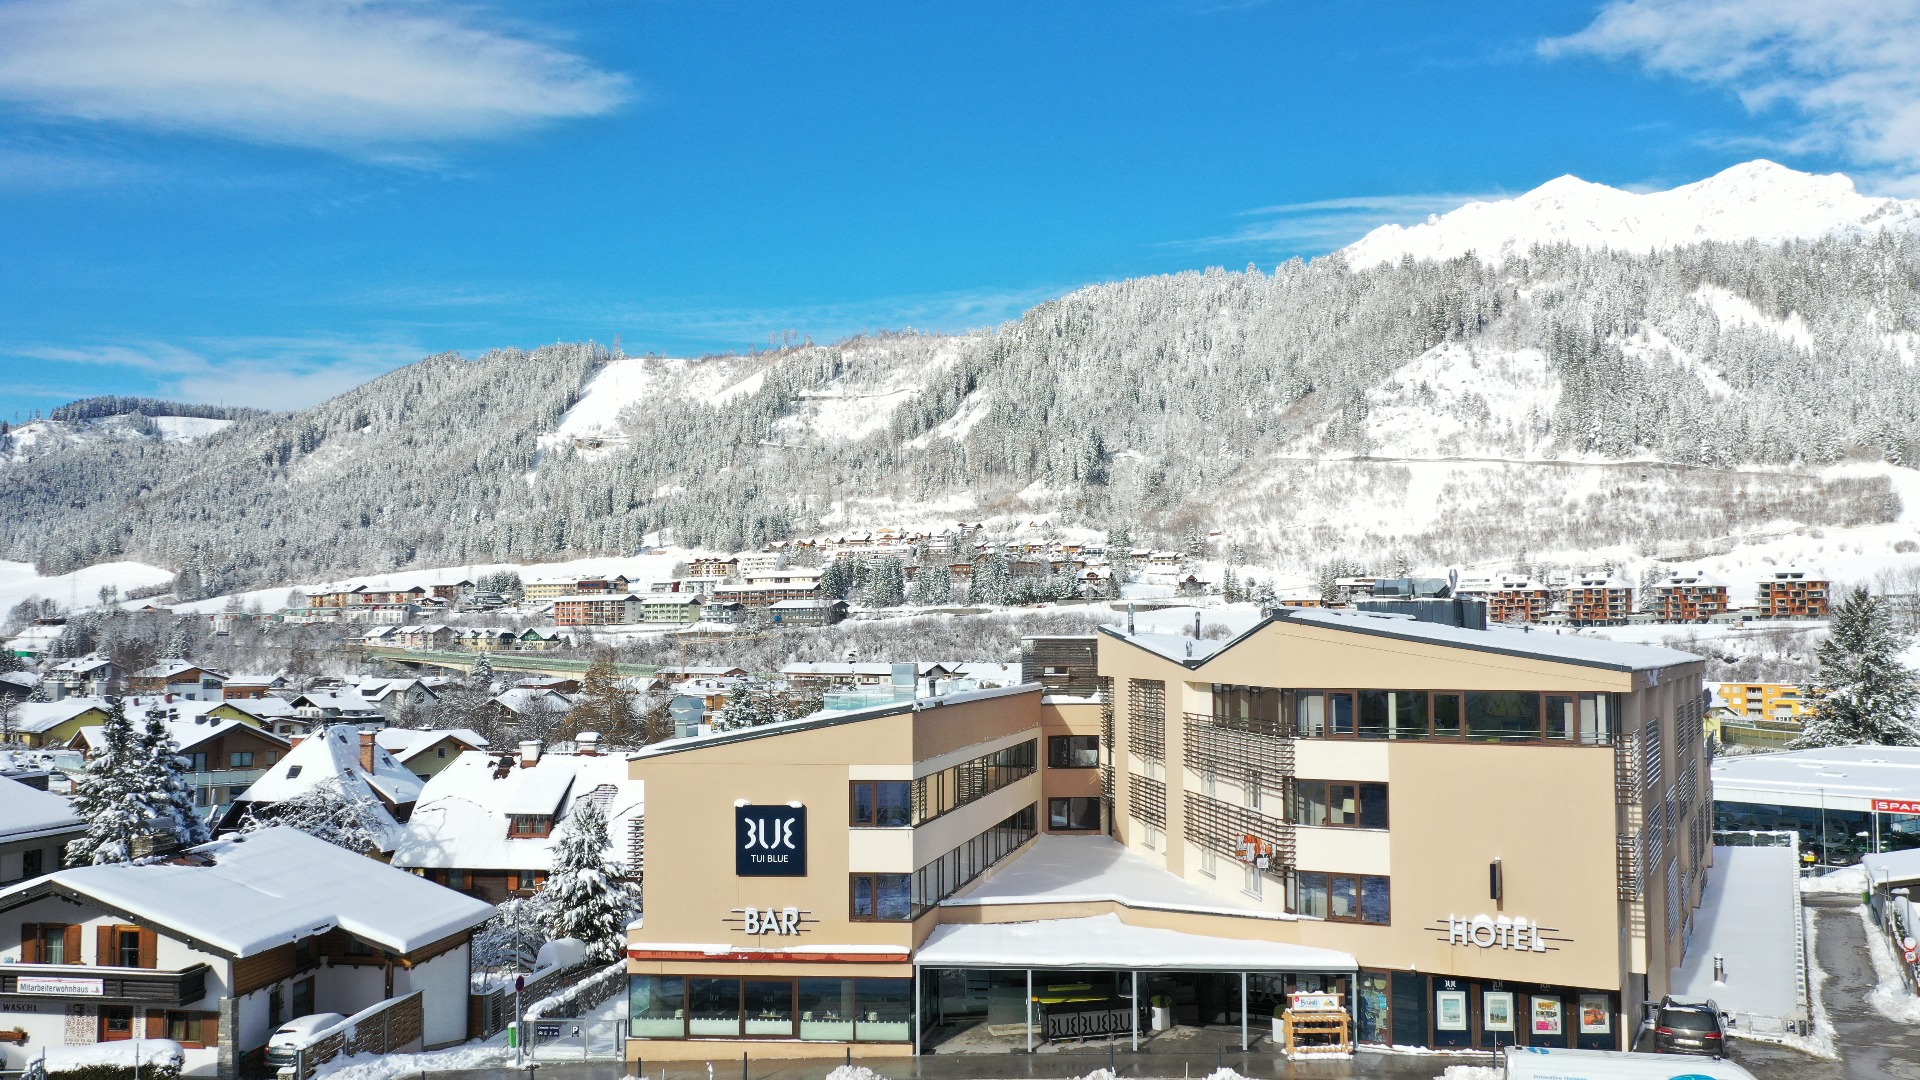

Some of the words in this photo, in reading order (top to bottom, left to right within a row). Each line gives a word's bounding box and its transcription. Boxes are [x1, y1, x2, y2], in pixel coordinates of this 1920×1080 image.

[1878, 801, 1920, 811] SPAR
[751, 854, 765, 863] TUI
[767, 854, 789, 863] BLUE
[745, 907, 799, 935] BAR
[1449, 918, 1546, 952] HOTEL
[20, 983, 89, 994] Mitarbeiterwohnhaus
[3, 1003, 38, 1012] WASCHL
[1787, 1020, 1794, 1028] P
[572, 1026, 578, 1034] P
